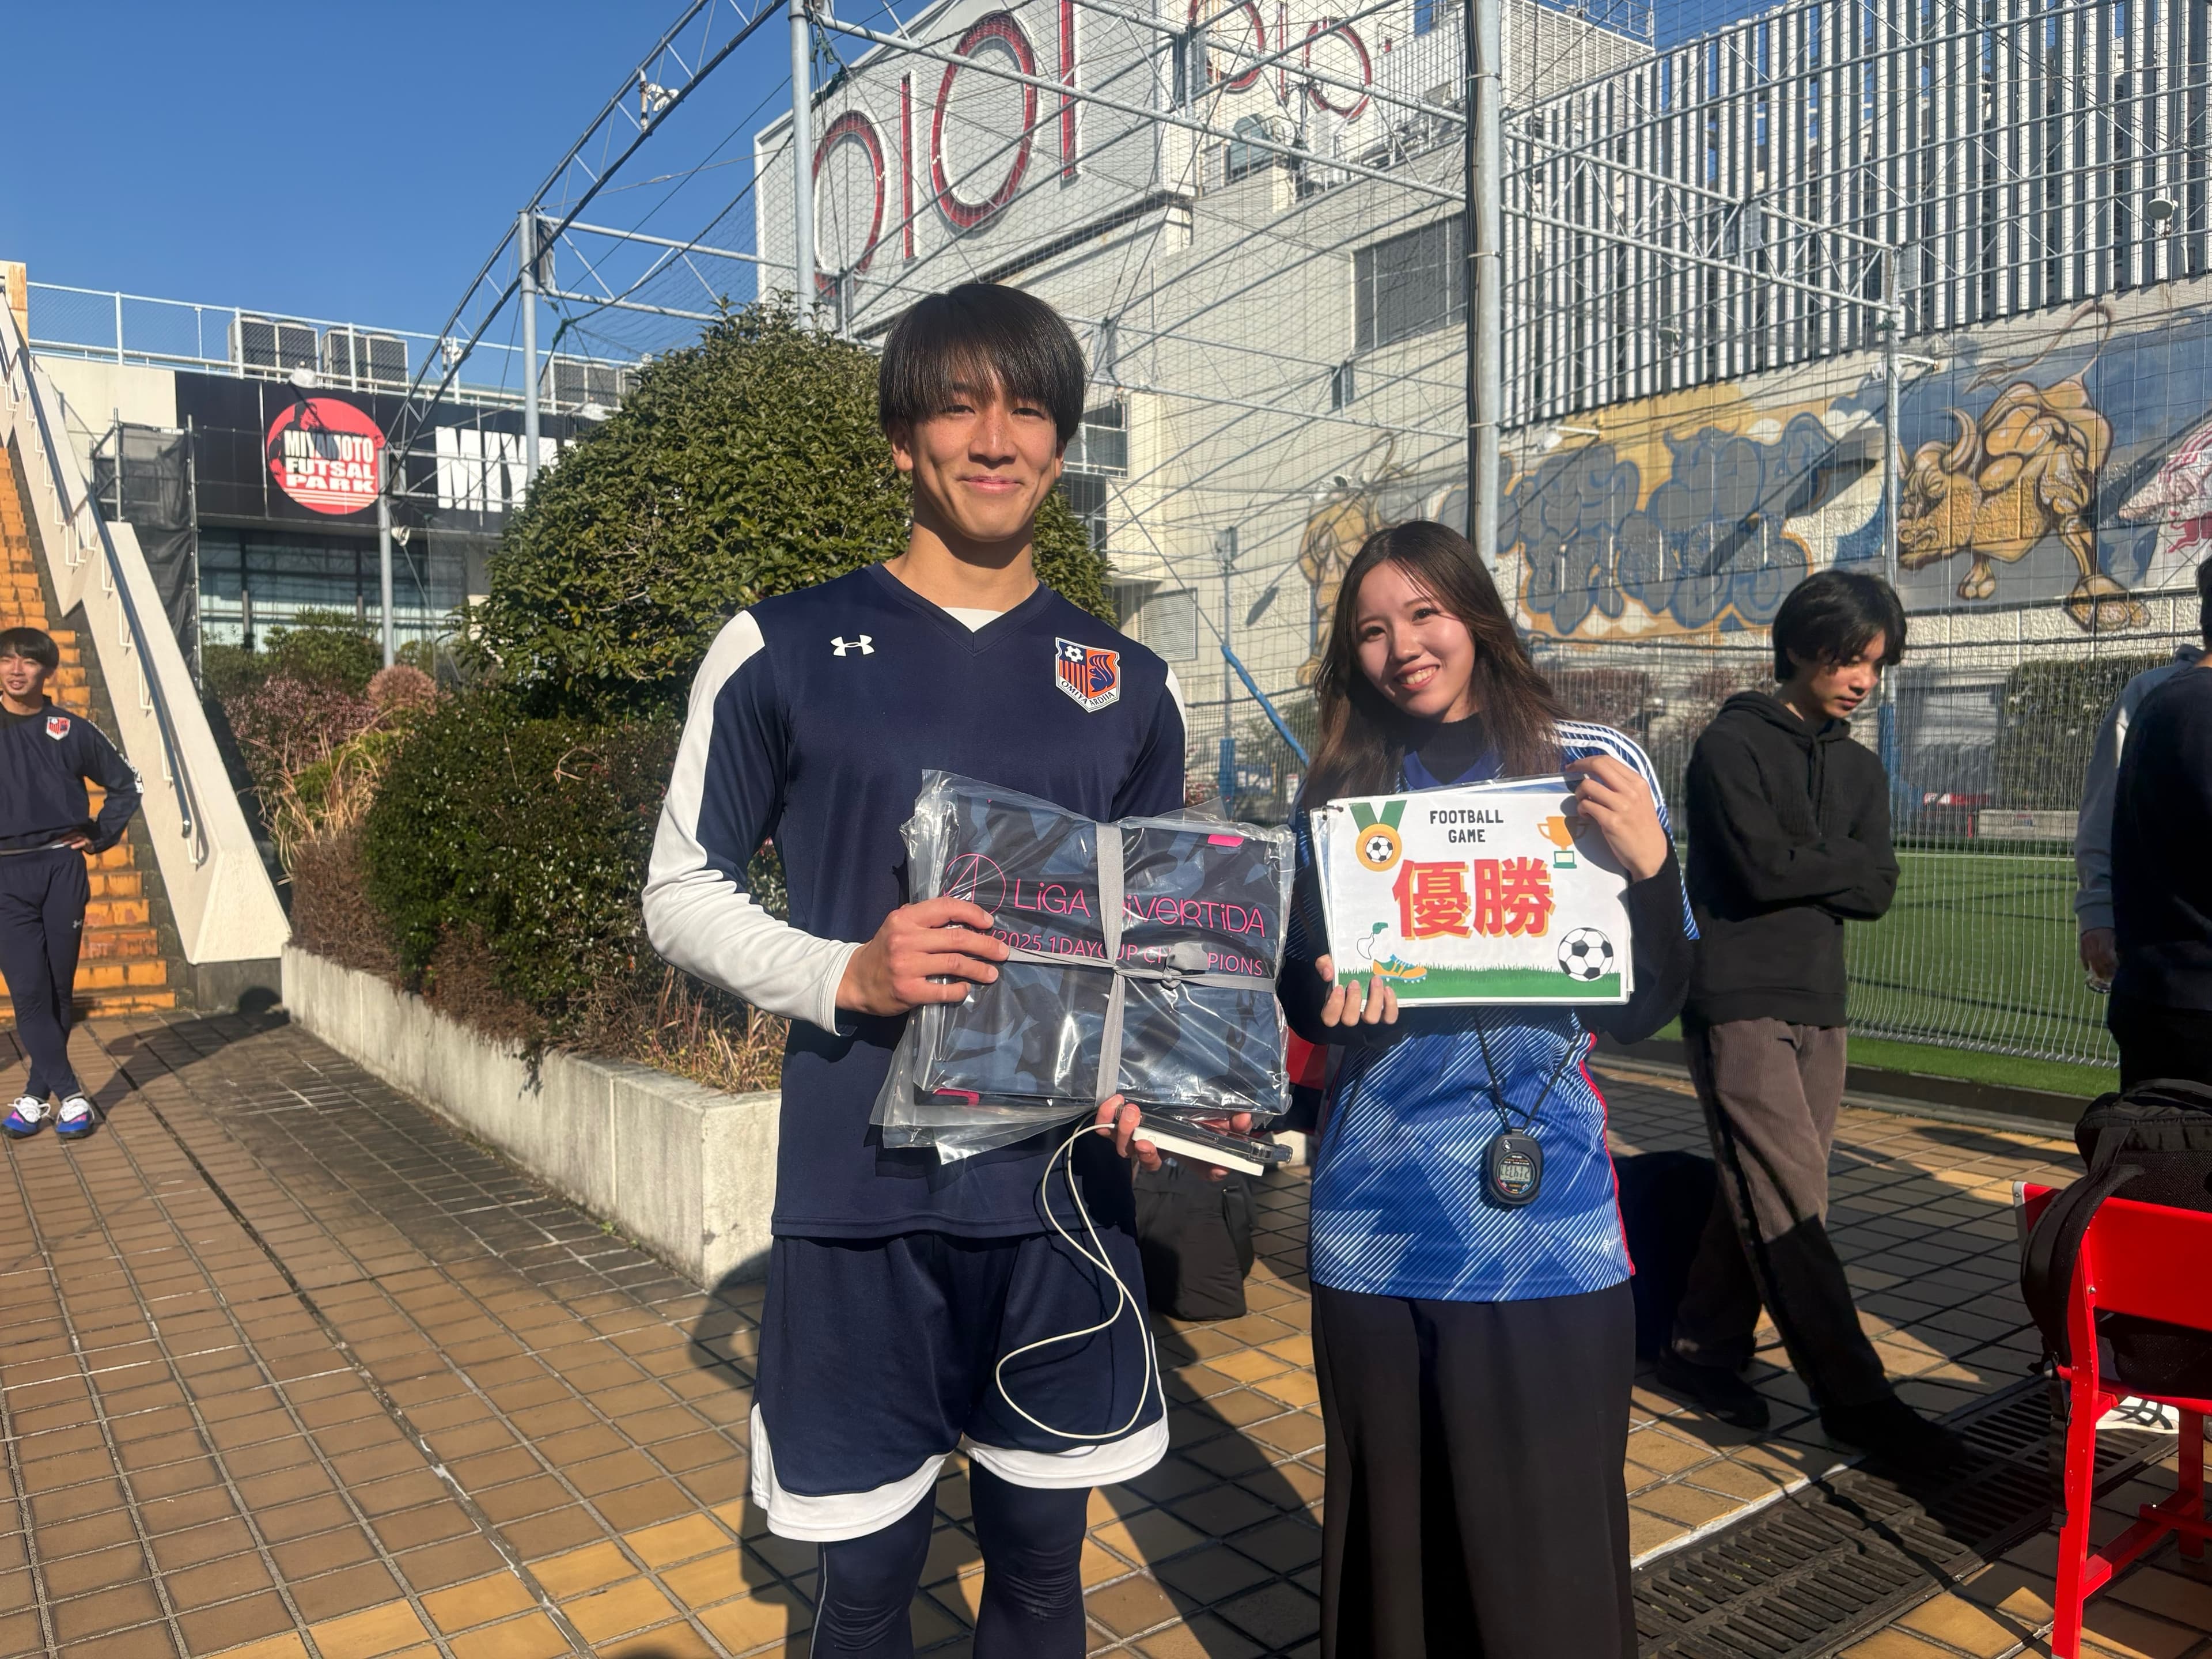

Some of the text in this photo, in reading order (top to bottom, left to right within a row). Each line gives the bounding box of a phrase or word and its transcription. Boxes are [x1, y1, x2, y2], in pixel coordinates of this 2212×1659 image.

[285, 457, 375, 480] FUTSAL
[286, 474, 374, 493] PARK
[1061, 680, 1088, 704] OMIYA
[1430, 809, 1504, 824] FOOTBALL
[1448, 828, 1486, 843] GAME
[1392, 856, 1556, 941] 優勝
[1143, 946, 1263, 976] CHPIONS
